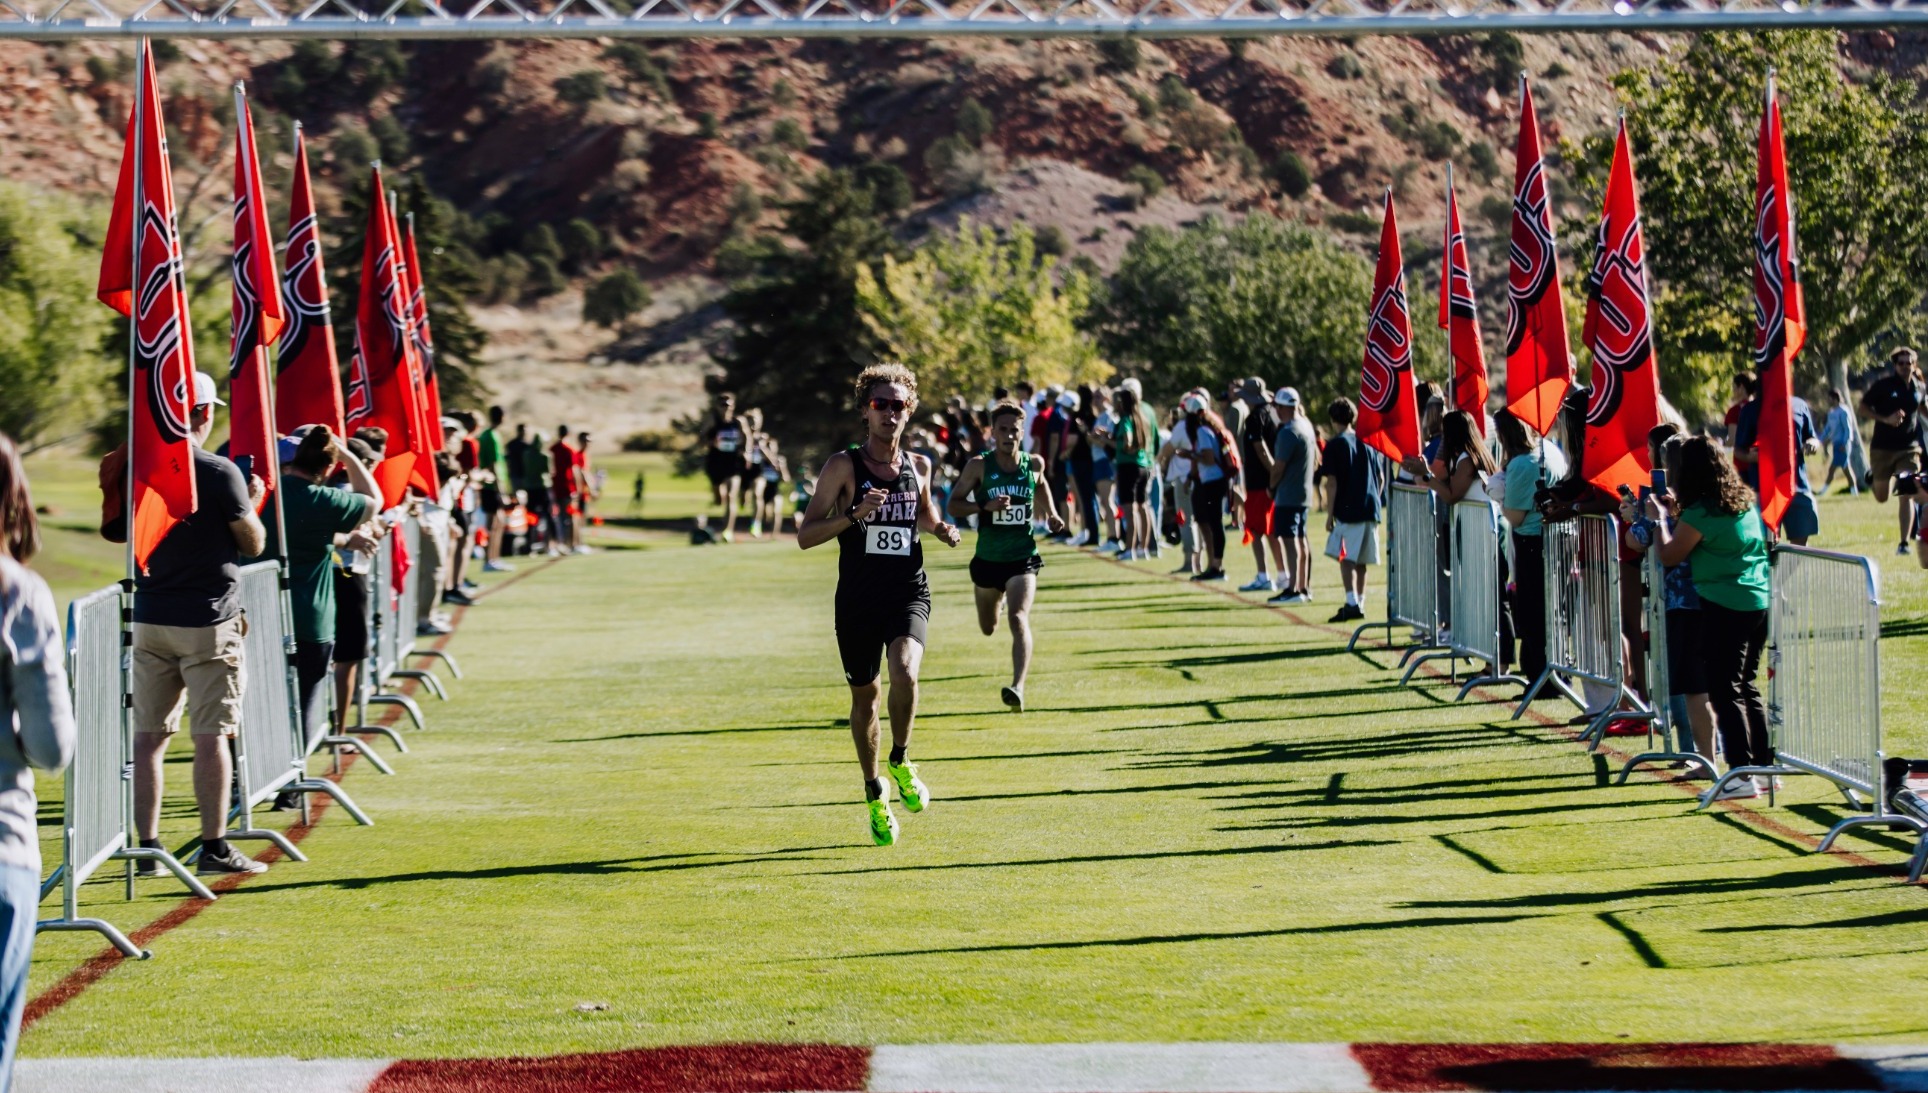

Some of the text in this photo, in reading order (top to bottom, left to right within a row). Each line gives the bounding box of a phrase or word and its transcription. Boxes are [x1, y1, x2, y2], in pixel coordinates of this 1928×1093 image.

[863, 501, 917, 523] UTAH
[995, 508, 1024, 522] 150
[876, 530, 903, 551] 89
